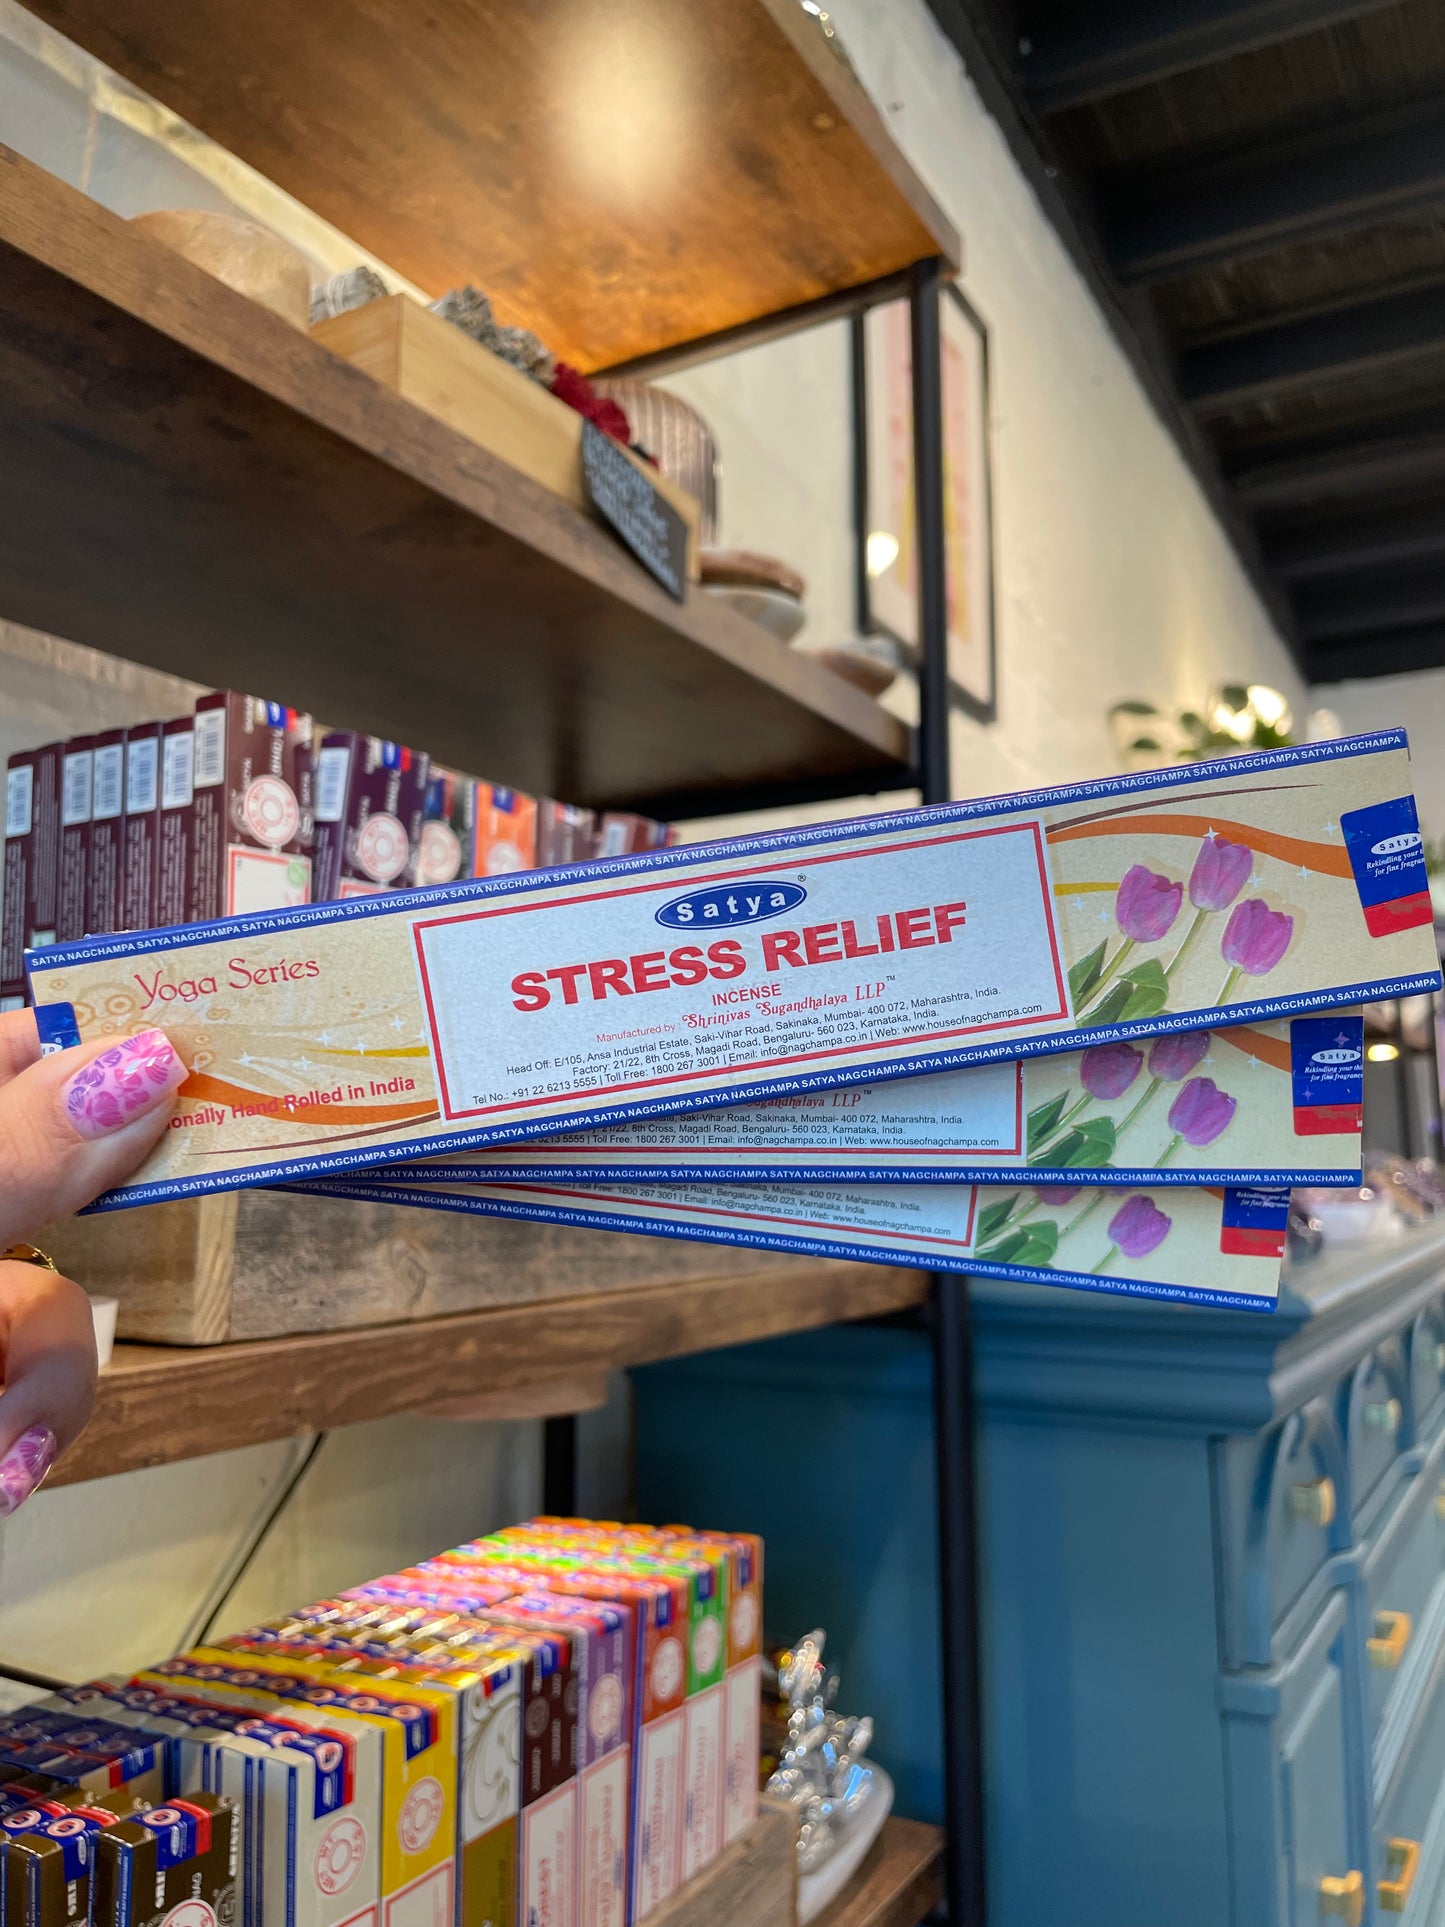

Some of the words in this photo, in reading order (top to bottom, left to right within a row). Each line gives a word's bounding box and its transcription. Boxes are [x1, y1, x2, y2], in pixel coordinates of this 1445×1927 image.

[33, 954, 64, 965] SATYA
[67, 942, 135, 960] NAGCHAMPA
[137, 936, 170, 948] SATYA
[172, 925, 240, 943] NAGCHAMPA
[241, 919, 275, 931] SATYA
[277, 907, 344, 926] NAGCHAMPA
[346, 902, 379, 914] SATYA
[381, 891, 448, 909] NAGCHAMPA
[450, 885, 483, 898] SATYA
[485, 874, 551, 892] NAGCHAMPA
[553, 869, 585, 881] SATYA
[587, 858, 653, 876] NAGCHAMPA
[655, 852, 688, 864] SATYA
[691, 841, 760, 858] NAGCHAMPA
[762, 835, 796, 847] SATYA
[798, 823, 867, 841] NAGCHAMPA
[869, 817, 903, 829] SATYA
[906, 806, 974, 823] NAGCHAMPA
[976, 800, 1010, 812] SATYA
[1013, 788, 1082, 805] NAGCHAMPA
[1084, 781, 1119, 794] SATYA
[1121, 769, 1190, 788] NAGCHAMPA
[1193, 763, 1227, 776] SATYA
[1229, 752, 1298, 770] NAGCHAMPA
[1301, 746, 1333, 758] SATYA
[1335, 735, 1400, 753] NAGCHAMPA
[1379, 836, 1418, 851] Satya
[1366, 855, 1402, 870] Rekindling
[1403, 850, 1419, 861] your
[677, 892, 786, 922] Satya
[510, 939, 747, 1013] STRESS
[761, 901, 966, 972] RELIEF
[134, 970, 218, 1010] Yoga
[228, 957, 320, 990] Series
[711, 983, 782, 1008] INCENSE
[596, 1024, 662, 1043] Manufactured
[663, 1023, 676, 1033] by
[682, 1010, 751, 1029] Shrinivas
[755, 993, 848, 1016] Sugandhalaya
[855, 982, 886, 1001] LLP
[506, 1063, 532, 1075] Head
[534, 1059, 552, 1070] Off:
[554, 1054, 585, 1068] E/105,
[587, 1051, 612, 1062] Ansa
[613, 1042, 657, 1057] Industrial
[658, 1038, 692, 1050] Estate,
[694, 1029, 742, 1044] Saki-Vihar
[744, 1023, 774, 1035] Road,
[775, 1016, 822, 1031] Sakinaka,
[824, 1010, 865, 1022] Mumbai-
[867, 1004, 886, 1015] 400
[887, 1001, 909, 1012] 072,
[910, 992, 973, 1008] Maharashtra,
[975, 987, 1001, 998] India.
[572, 1063, 610, 1076] Factory:
[612, 1056, 643, 1070] 21/22,
[645, 1054, 660, 1064] 8th
[662, 1050, 691, 1061] Cross,
[695, 1042, 731, 1056] Magadi
[732, 1037, 761, 1049] Road,
[763, 1030, 815, 1045] Bengaluru-
[817, 1024, 835, 1036] 560
[836, 1021, 858, 1032] 023,
[860, 1014, 911, 1029] Karnataka,
[913, 1009, 939, 1020] India.
[472, 1094, 487, 1105] Tel
[489, 1092, 509, 1102] No.:
[512, 1087, 529, 1098] +91
[532, 1084, 545, 1095] 22
[546, 1080, 571, 1093] 6213
[573, 1076, 597, 1088] 5555
[604, 1072, 621, 1083] Toll
[623, 1069, 649, 1080] Free:
[651, 1063, 675, 1075] 1800
[676, 1059, 694, 1071] 267
[696, 1055, 720, 1068] 3001
[728, 1049, 758, 1062] Email:
[760, 1033, 868, 1057] info@nagchampa.co.in
[874, 1026, 900, 1038] Web:
[902, 1004, 1042, 1034] www.houseofnagchampa.com
[1319, 1053, 1355, 1061] Satya
[113, 1184, 179, 1202] NAGCHAMPA
[182, 1179, 214, 1191] SATYA
[217, 1167, 283, 1185] NAGCHAMPA
[285, 1162, 318, 1174] SATYA
[320, 1150, 386, 1168] NAGCHAMPA
[388, 1144, 421, 1156] SATYA
[423, 1133, 490, 1150] NAGCHAMPA
[491, 1127, 524, 1139] SATYA
[526, 1116, 592, 1133] NAGCHAMPA
[593, 1110, 626, 1122] SATYA
[628, 1098, 693, 1117] NAGCHAMPA
[694, 1092, 728, 1105] SATYA
[731, 1081, 799, 1099] NAGCHAMPA
[801, 1075, 835, 1087] SATYA
[837, 1063, 905, 1081] NAGCHAMPA
[907, 1058, 941, 1070] SATYA
[944, 1046, 1012, 1064] NAGCHAMPA
[1014, 1040, 1048, 1052] SATYA
[1050, 1029, 1119, 1046] NAGCHAMPA
[1121, 1022, 1156, 1035] SATYA
[1158, 1011, 1227, 1029] NAGCHAMPA
[1229, 1005, 1263, 1018] SATYA
[1266, 994, 1334, 1012] NAGCHAMPA
[1336, 988, 1369, 1000] SATYA
[1371, 977, 1437, 994] NAGCHAMPA
[230, 1098, 279, 1119] Hand
[284, 1086, 343, 1112] Rolled
[347, 1083, 366, 1101] in
[369, 1076, 416, 1097] India
[832, 1093, 861, 1107] LLP
[648, 1123, 676, 1133] Cross,
[678, 1124, 711, 1135] Magadi
[713, 1124, 739, 1134] Road,
[742, 1124, 790, 1135] Bengaluru-
[832, 1125, 879, 1135] Karnataka,
[679, 1114, 725, 1122] Saki-Vihar
[727, 1113, 753, 1122] Road,
[755, 1113, 798, 1123] Sakinaka,
[800, 1114, 839, 1123] Mumbai-
[881, 1114, 938, 1124] Maharashtra,
[941, 1115, 964, 1124] India.
[592, 1134, 608, 1143] Toll
[610, 1134, 632, 1144] Free:
[635, 1134, 657, 1144] 1800
[708, 1135, 735, 1144] Email:
[737, 1135, 837, 1146] info@nagchampa.co.in
[844, 1136, 867, 1145] Web:
[869, 1136, 999, 1148] www.houseofnagchampa.com
[1001, 1172, 1063, 1180] NAGCHAMPA
[1098, 1280, 1127, 1289] SATYA
[1129, 1284, 1186, 1297] NAGCHAMPA
[1188, 1291, 1214, 1301] SATYA
[1216, 1294, 1270, 1308] NAGCHAMPA
